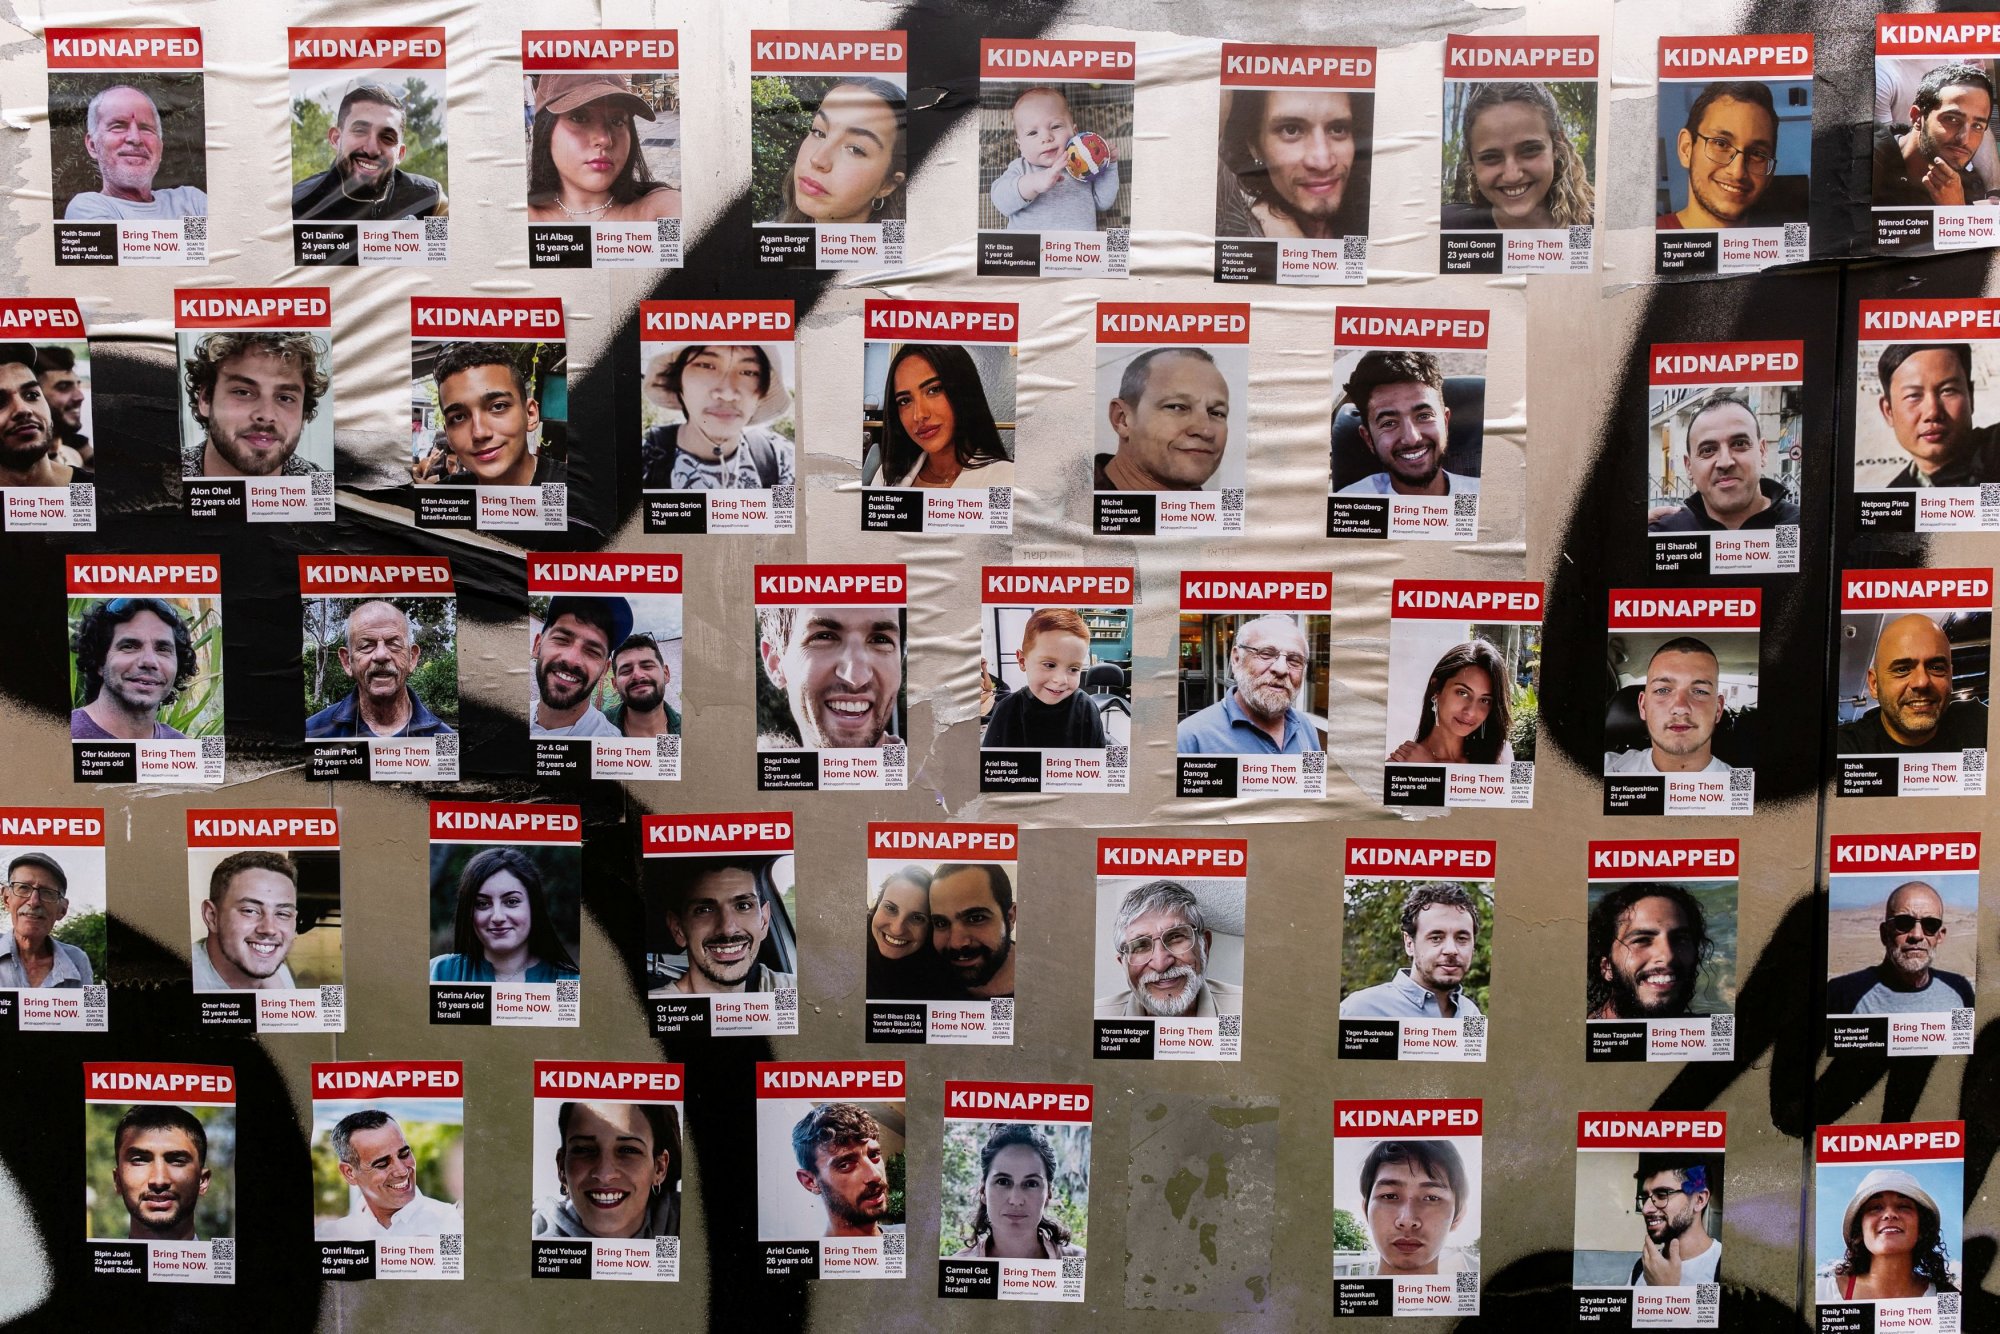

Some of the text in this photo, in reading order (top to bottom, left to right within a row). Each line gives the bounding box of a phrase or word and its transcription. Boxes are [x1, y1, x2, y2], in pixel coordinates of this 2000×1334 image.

[53, 38, 200, 57] KIDNAPPED
[527, 39, 675, 58] KIDNAPPED
[757, 41, 903, 61] KIDNAPPED
[987, 48, 1134, 68] KIDNAPPED
[1450, 47, 1595, 67] KIDNAPPED
[1664, 46, 1809, 67] KIDNAPPED
[1905, 218, 1929, 226] Cohen
[301, 231, 344, 240] Ori Danino
[1878, 228, 1887, 236] 19
[1888, 229, 1908, 237] years
[535, 233, 574, 243] Liri Albag
[1878, 237, 1900, 245] Israeli
[302, 242, 350, 252] 24 years old
[536, 243, 584, 253] 18 years old
[1447, 240, 1496, 249] Romi Gonen
[302, 252, 327, 260] Israeli
[536, 253, 560, 262] Israeli
[1282, 248, 1338, 260] Bring Them
[1447, 251, 1494, 261] 23 years old
[1282, 261, 1339, 270] Home NOW.
[1447, 261, 1471, 269] Israeli
[181, 298, 327, 317] KIDNAPPED
[417, 308, 560, 327] KIDNAPPED
[646, 312, 791, 330] KIDNAPPED
[1102, 314, 1246, 332] KIDNAPPED
[1341, 317, 1485, 338] KIDNAPPED
[1655, 352, 1799, 374] KIDNAPPED
[9, 497, 64, 508] Bring Them
[191, 497, 241, 508] 22 years old
[679, 501, 702, 509] Serion
[928, 498, 983, 510] Bring Them
[10, 509, 66, 518] Home NOW.
[191, 508, 217, 516] Israeli
[660, 511, 679, 519] years
[928, 510, 984, 520] Home NOW.
[651, 518, 667, 526] Thai
[1656, 542, 1697, 551] Eli Sharabi
[1655, 552, 1702, 562] 51 years old
[1655, 562, 1679, 571] Israeli
[74, 565, 218, 583] KIDNAPPED
[307, 565, 449, 583] KIDNAPPED
[761, 576, 903, 593] KIDNAPPED
[988, 575, 1130, 594] KIDNAPPED
[1847, 579, 1989, 599] KIDNAPPED
[1186, 581, 1327, 600] KIDNAPPED
[1614, 599, 1756, 617] KIDNAPPED
[81, 750, 131, 758] Ofer Kalderon
[82, 768, 103, 776] Israeli
[1183, 770, 1209, 778] Dancyg
[1192, 779, 1211, 787] years
[1450, 773, 1504, 784] Bring Them
[1871, 778, 1883, 786] old
[1183, 786, 1203, 794] Israeli
[1450, 785, 1505, 794] Home NOW.
[436, 812, 578, 831] KIDNAPPED
[194, 819, 336, 837] KIDNAPPED
[875, 831, 1015, 850] KIDNAPPED
[1837, 842, 1977, 862] KIDNAPPED
[1351, 848, 1491, 867] KIDNAPPED
[261, 999, 316, 1009] Bring Them
[656, 1004, 687, 1014] Or Levy
[261, 1010, 317, 1019] Home NOW.
[657, 1013, 704, 1024] 33 years old
[657, 1024, 681, 1032] Israeli
[1893, 1022, 1946, 1033] Bring Them
[1892, 1033, 1947, 1043] Home NOW.
[92, 1072, 232, 1092] KIDNAPPED
[540, 1071, 680, 1090] KIDNAPPED
[1340, 1109, 1479, 1127] KIDNAPPED
[1822, 1131, 1960, 1152] KIDNAPPED
[321, 1246, 365, 1255] Omri Miran
[322, 1256, 369, 1266] 46 years old
[322, 1266, 346, 1274] Israeli
[945, 1266, 988, 1275] Carmel Gat
[945, 1275, 955, 1283] 39
[956, 1277, 977, 1285] years
[945, 1285, 968, 1293] Israeli
[1580, 1297, 1606, 1305] Evyatar
[1589, 1306, 1609, 1314] years
